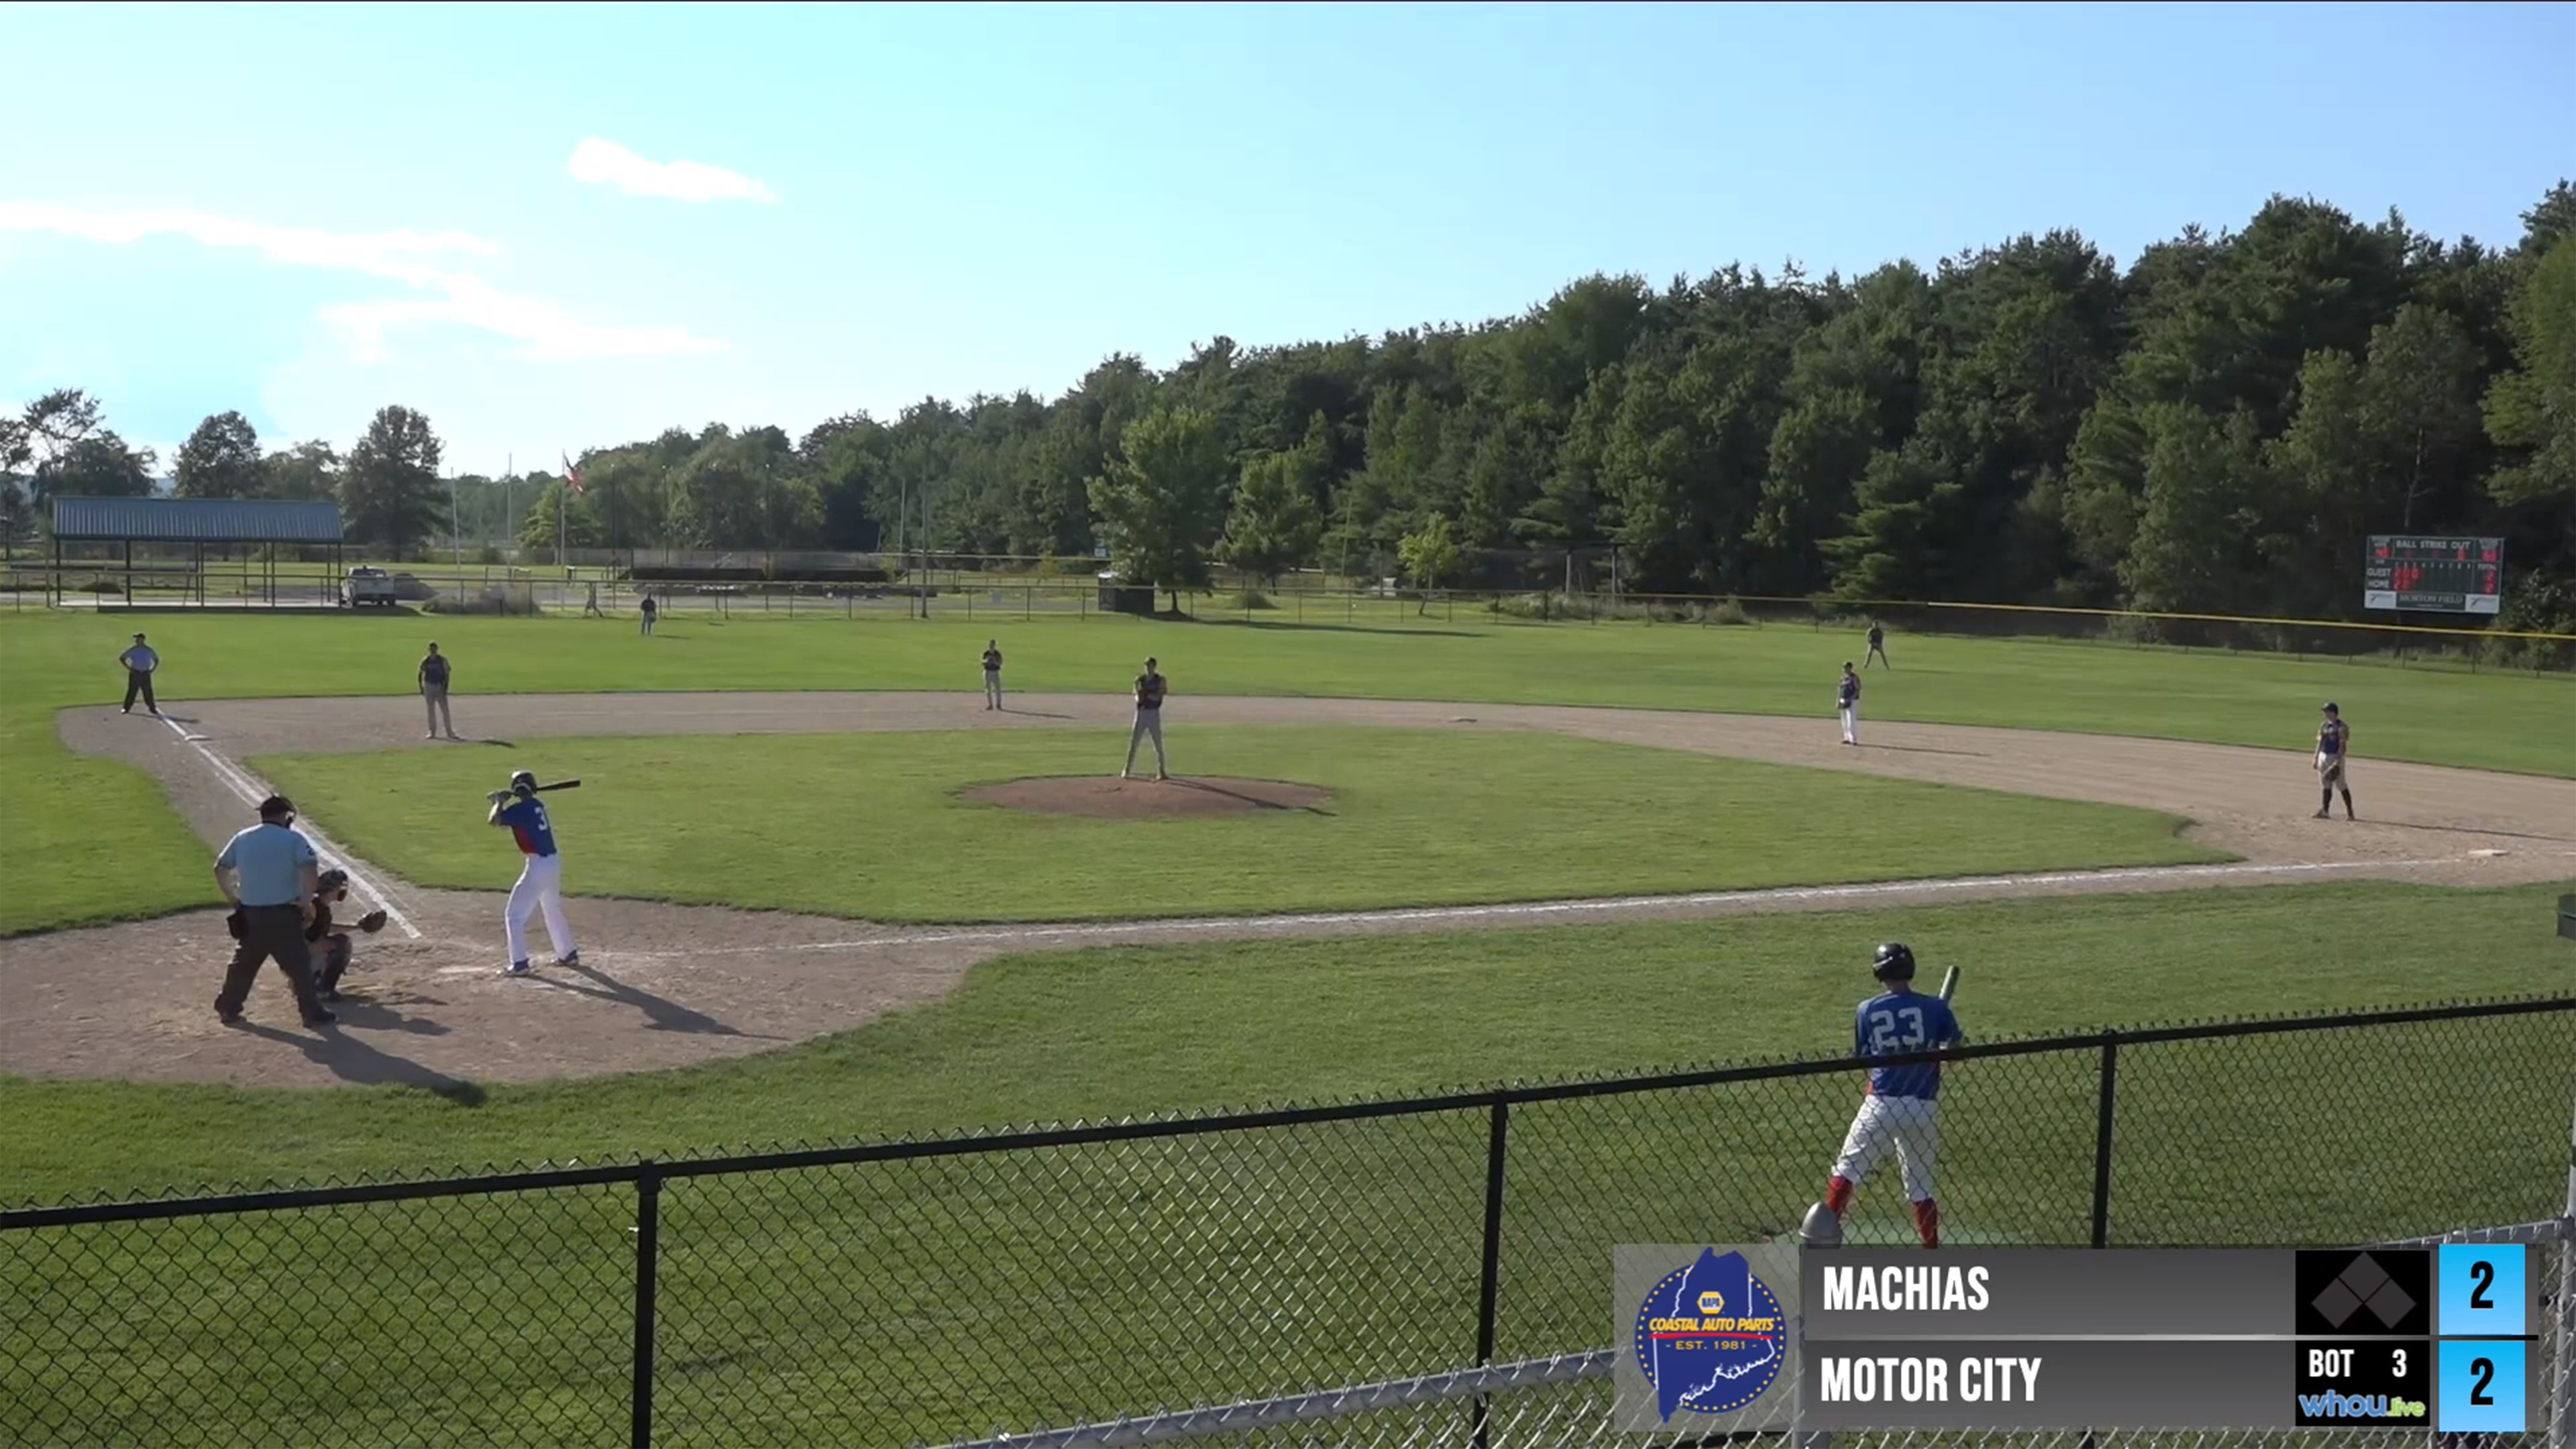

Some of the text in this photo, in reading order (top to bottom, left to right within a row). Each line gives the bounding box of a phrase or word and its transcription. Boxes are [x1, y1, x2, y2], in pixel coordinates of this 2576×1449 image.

[2396, 540, 2416, 548] BALL
[2420, 541, 2447, 549] STRIKE
[2451, 541, 2470, 549] OUT
[2367, 580, 2390, 588] HOME
[1870, 1008, 1925, 1046] 23
